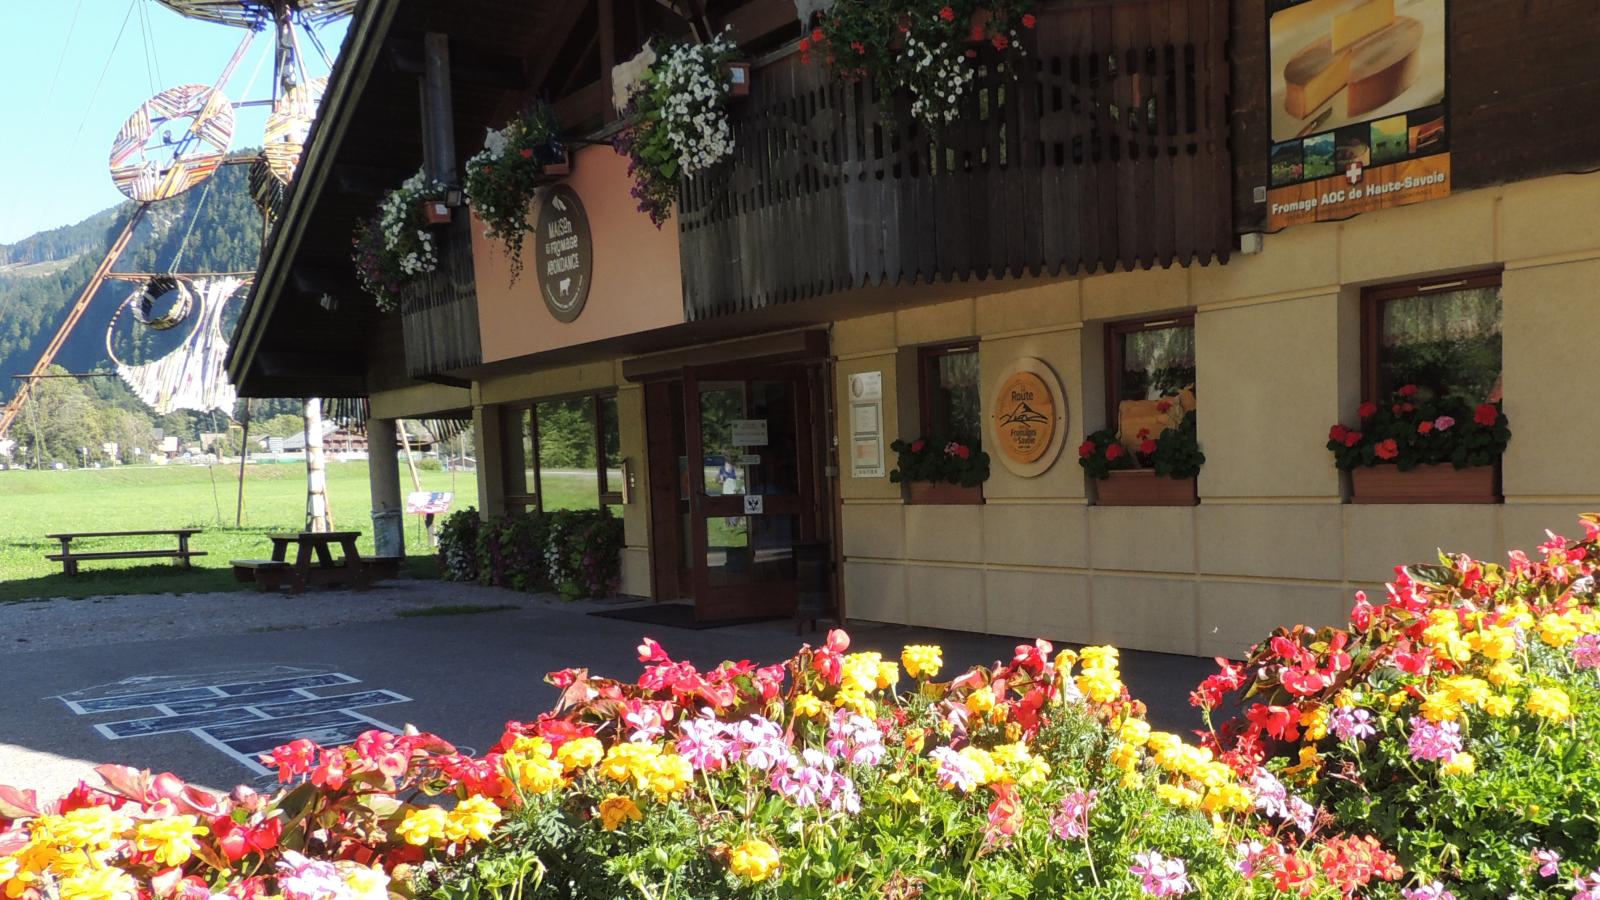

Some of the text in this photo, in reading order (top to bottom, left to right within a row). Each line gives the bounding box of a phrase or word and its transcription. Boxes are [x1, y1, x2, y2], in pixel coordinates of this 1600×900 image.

[1272, 198, 1318, 215] Fromage
[1321, 190, 1345, 206] AOC
[1348, 188, 1363, 200] de
[1366, 171, 1445, 197] Haute-Savoie
[1011, 391, 1034, 402] Route
[1010, 428, 1036, 438] Fromages
